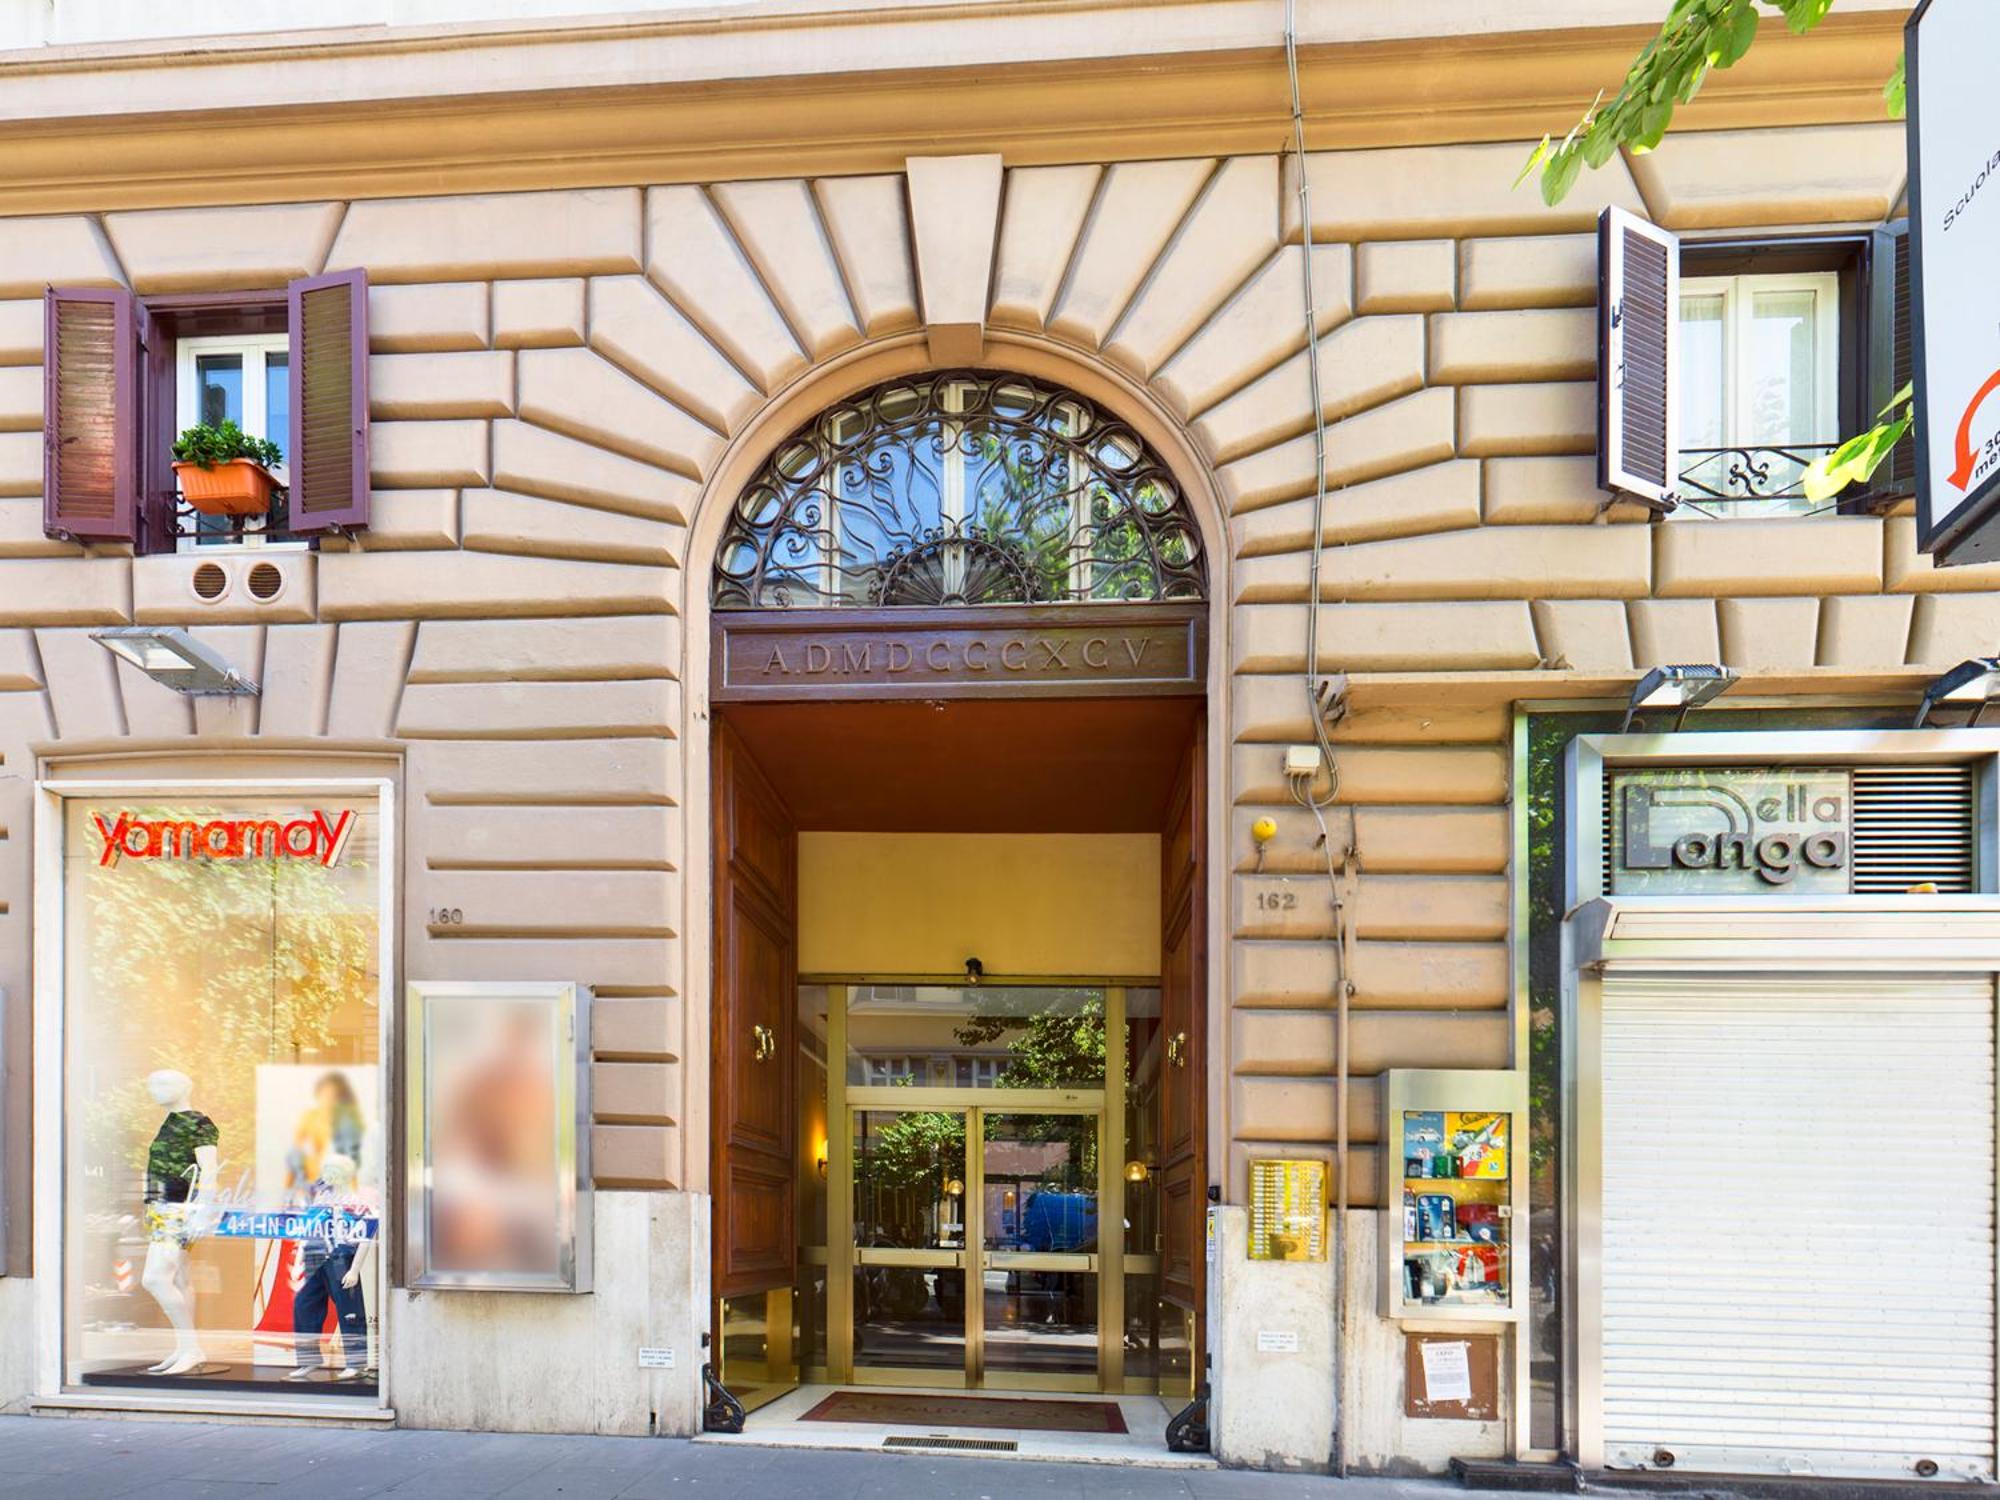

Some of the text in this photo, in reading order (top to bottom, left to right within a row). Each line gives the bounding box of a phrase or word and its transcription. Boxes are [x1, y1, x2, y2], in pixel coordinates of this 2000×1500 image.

[1943, 149, 2000, 231] Scuola
[1976, 446, 2000, 479] me
[1257, 892, 1297, 910] 162
[430, 906, 463, 925] 160
